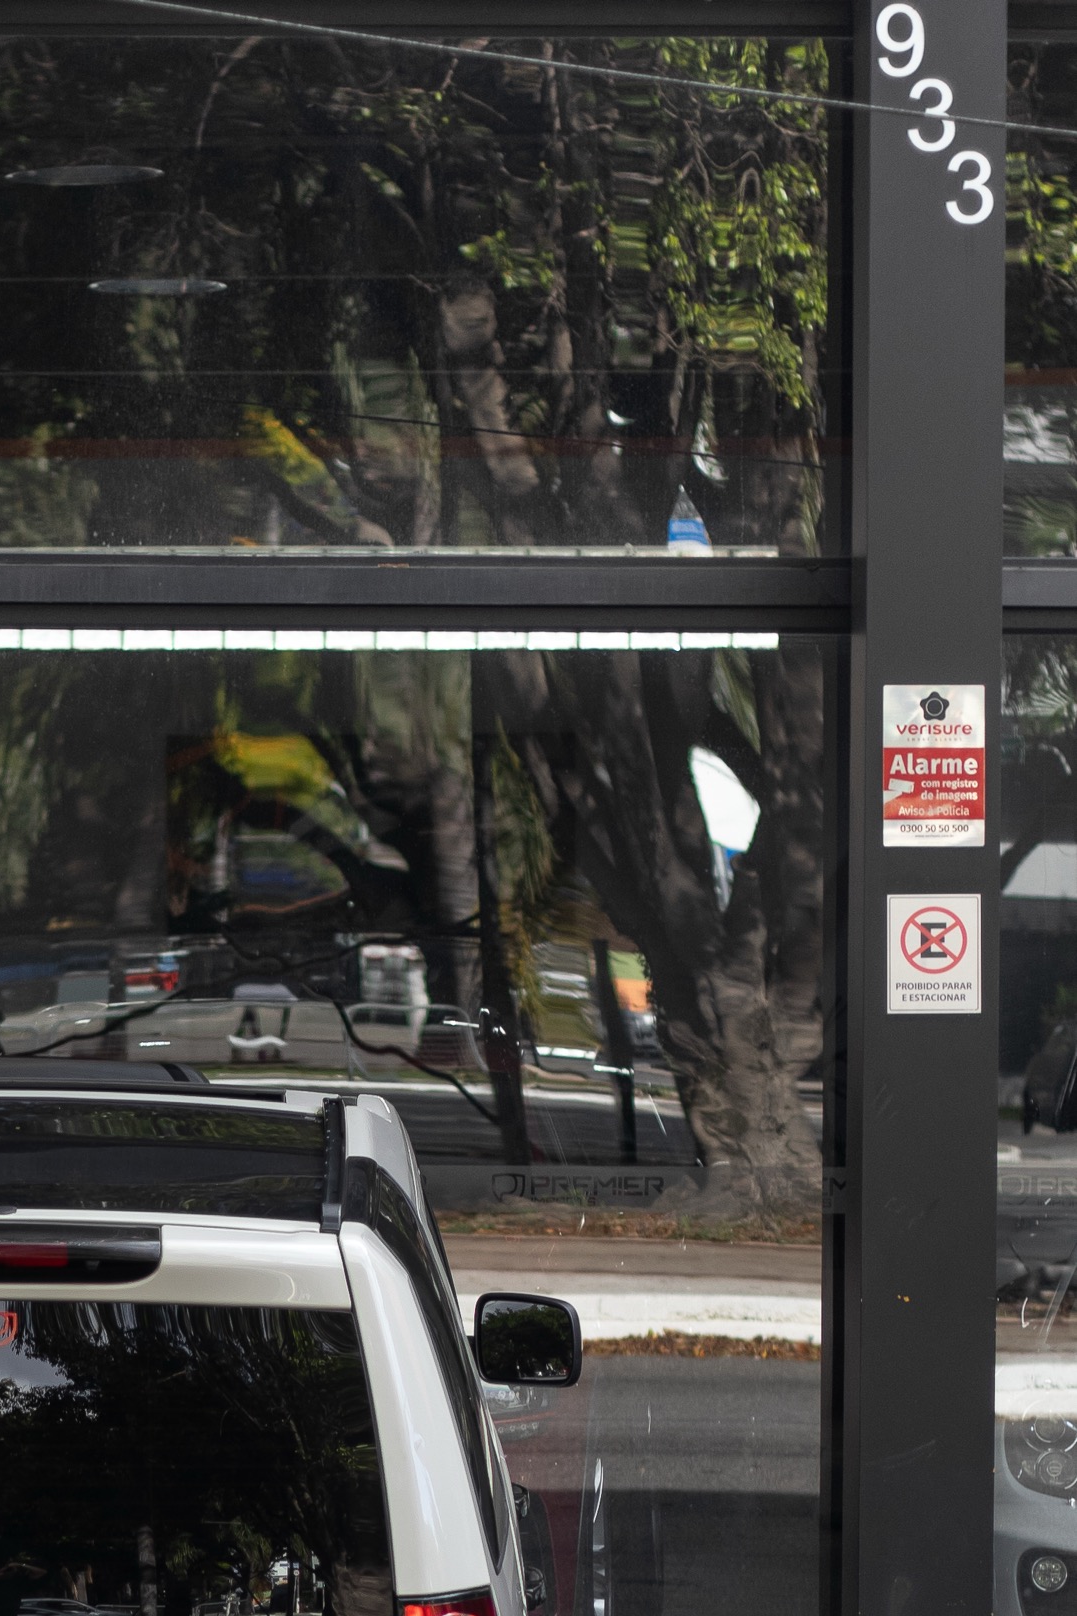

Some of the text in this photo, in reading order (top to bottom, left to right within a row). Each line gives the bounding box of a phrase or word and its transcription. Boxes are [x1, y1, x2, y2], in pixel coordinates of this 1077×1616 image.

[896, 723, 973, 736] verisure
[889, 752, 978, 776] Alarme
[921, 777, 978, 790] com registro
[921, 789, 978, 802] de imagens
[898, 805, 924, 816] Aviso
[900, 824, 969, 833] 0300 50 50 500
[895, 982, 972, 990] PROIBIDO PARAR
[902, 994, 966, 1002] E ESTACIONAR
[530, 1175, 665, 1197] PREMIER
